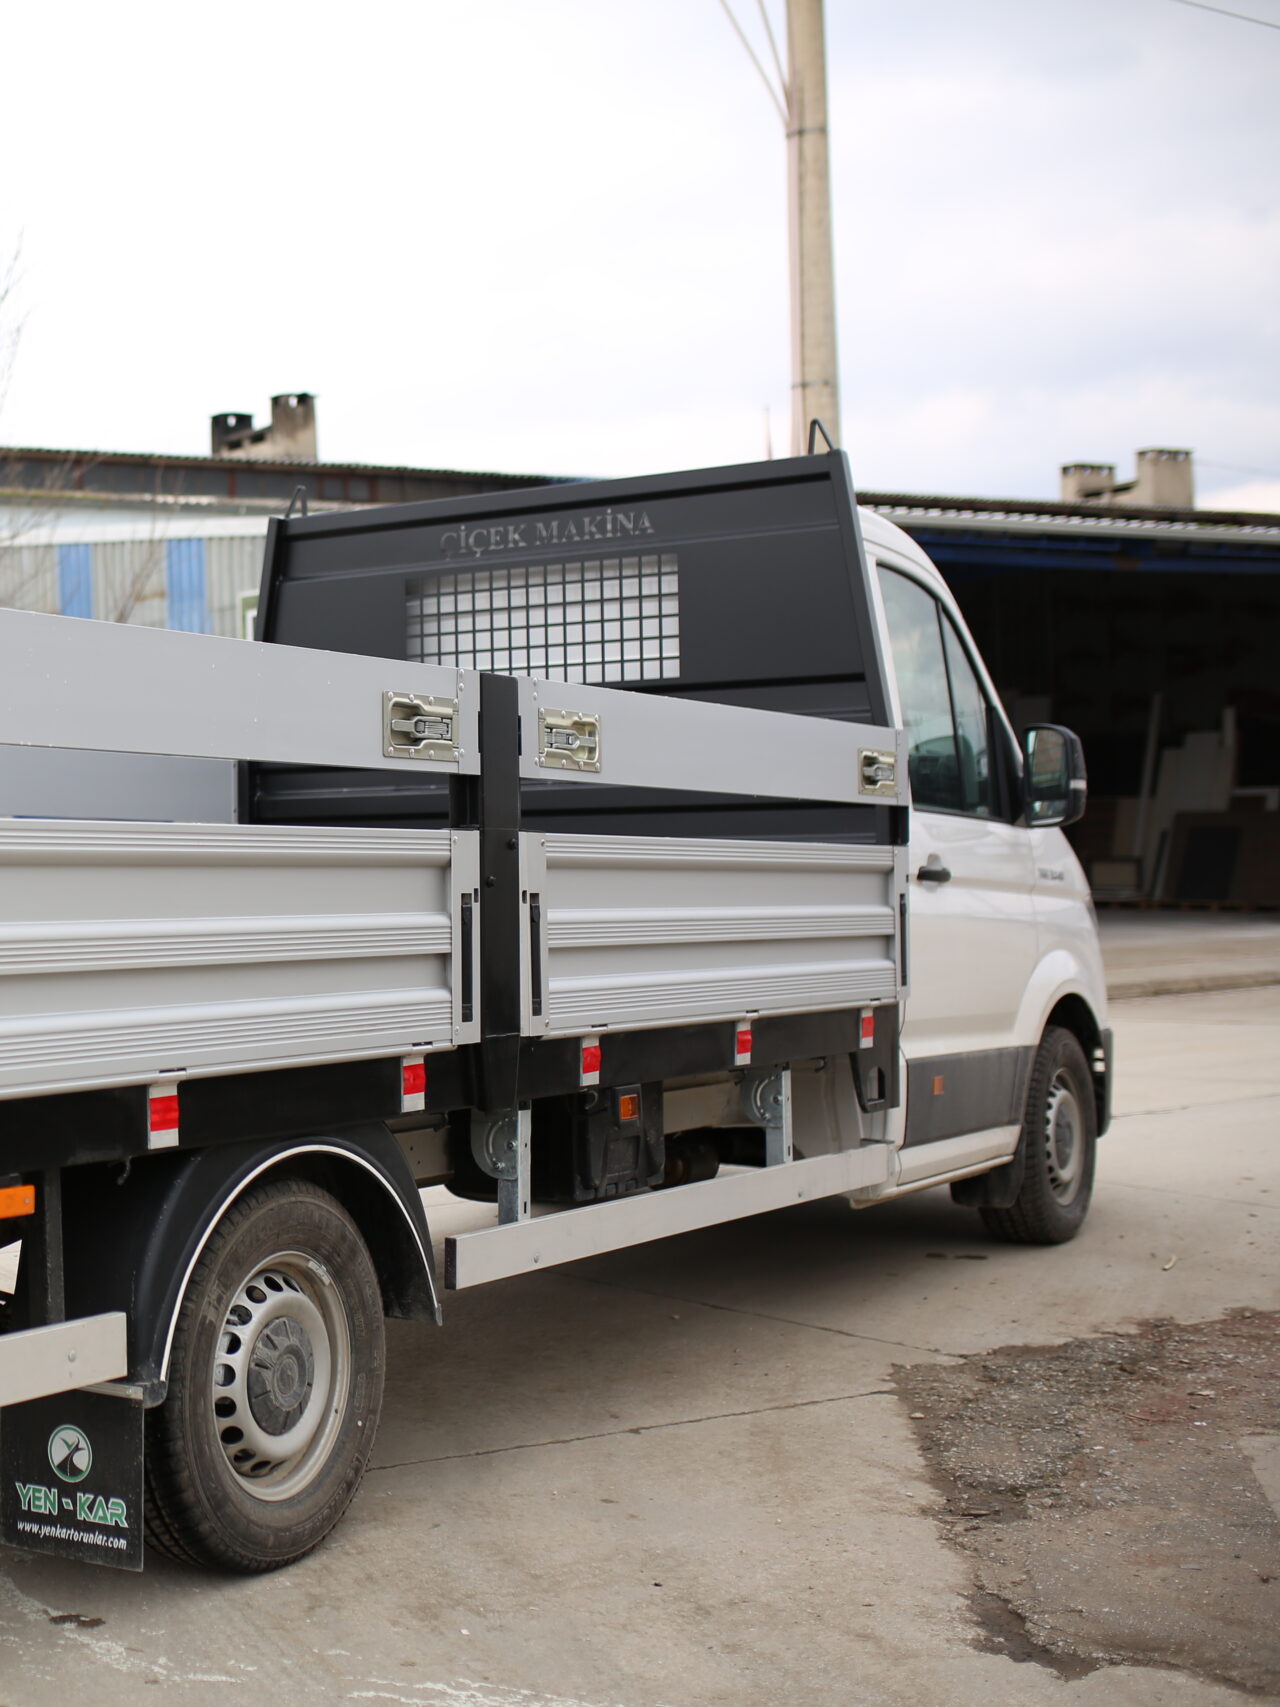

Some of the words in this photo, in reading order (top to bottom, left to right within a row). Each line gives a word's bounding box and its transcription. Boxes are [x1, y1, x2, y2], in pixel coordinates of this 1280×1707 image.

[535, 508, 655, 546] MAKİNA
[15, 1481, 58, 1515] YEN
[76, 1491, 129, 1528] KAR
[17, 1520, 127, 1550] www.yenkartorunlar.com
